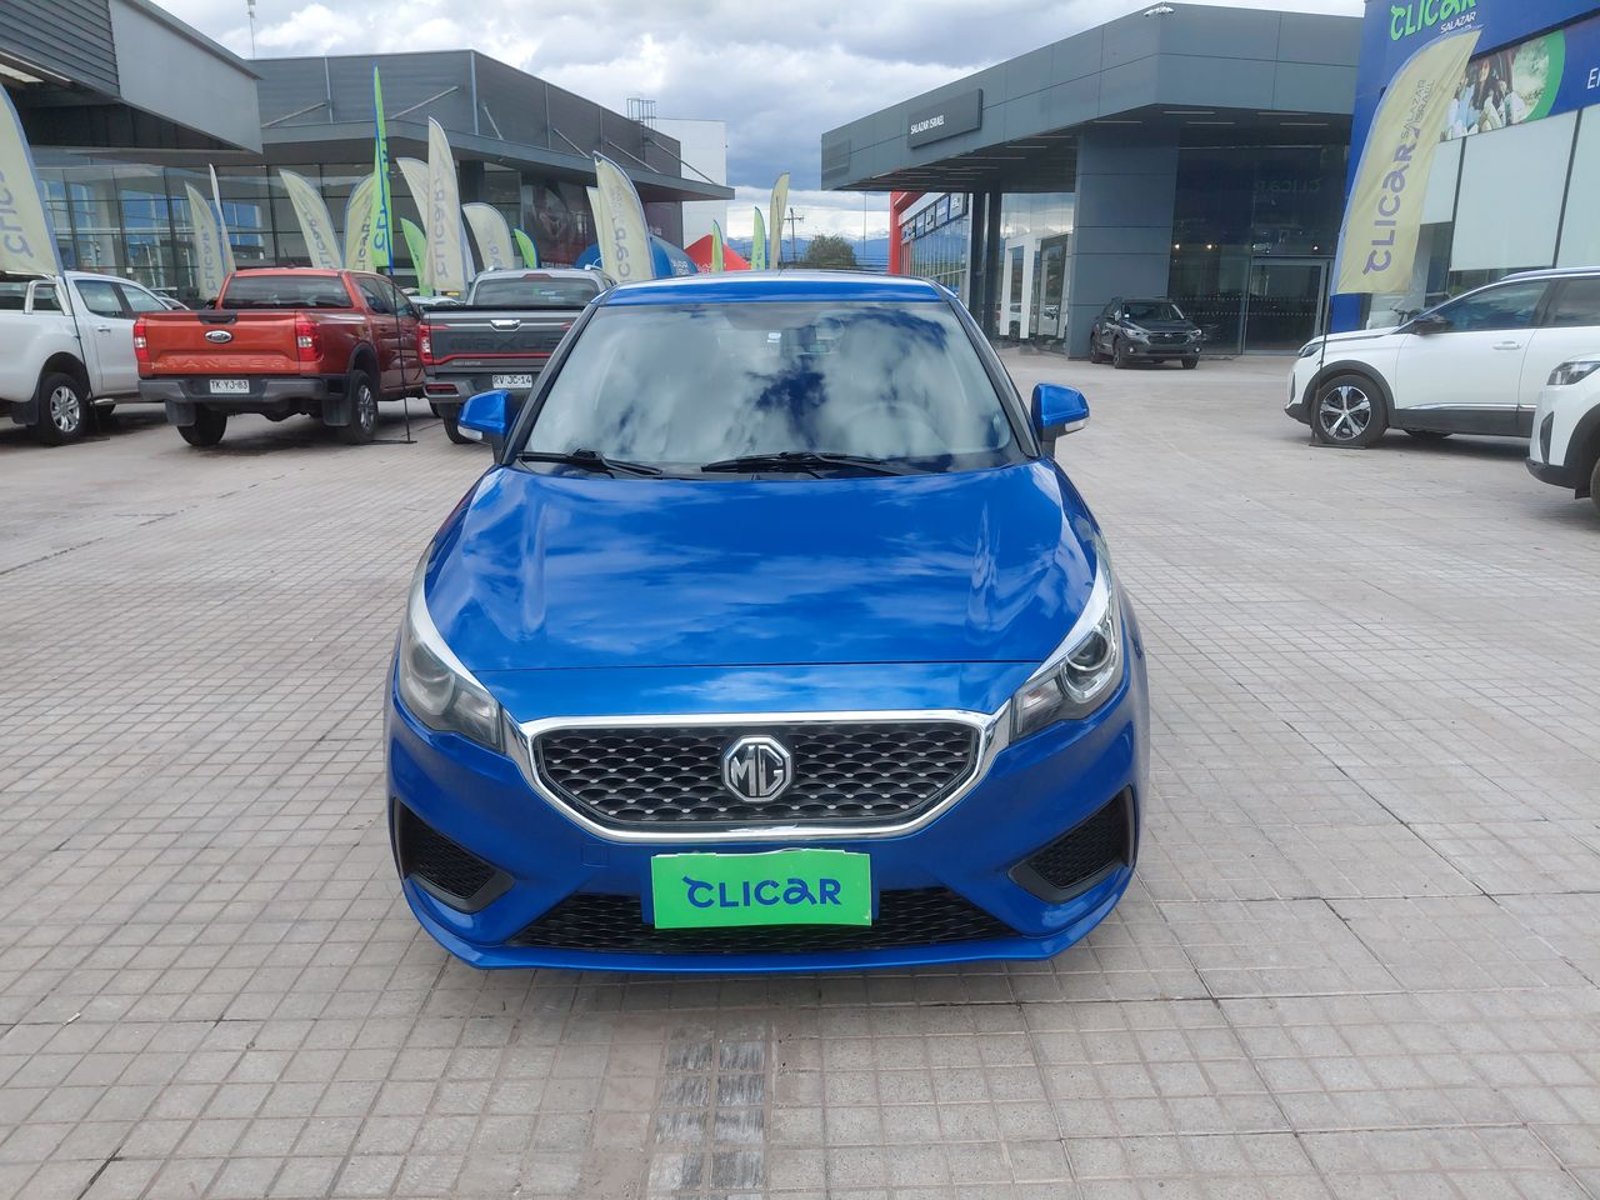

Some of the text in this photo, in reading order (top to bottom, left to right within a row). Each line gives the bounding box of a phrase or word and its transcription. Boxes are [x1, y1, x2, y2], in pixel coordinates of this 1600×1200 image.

[1441, 12, 1476, 33] SALAZAR
[910, 115, 944, 135] SALAZAR ISRAEL
[730, 745, 783, 797] MG
